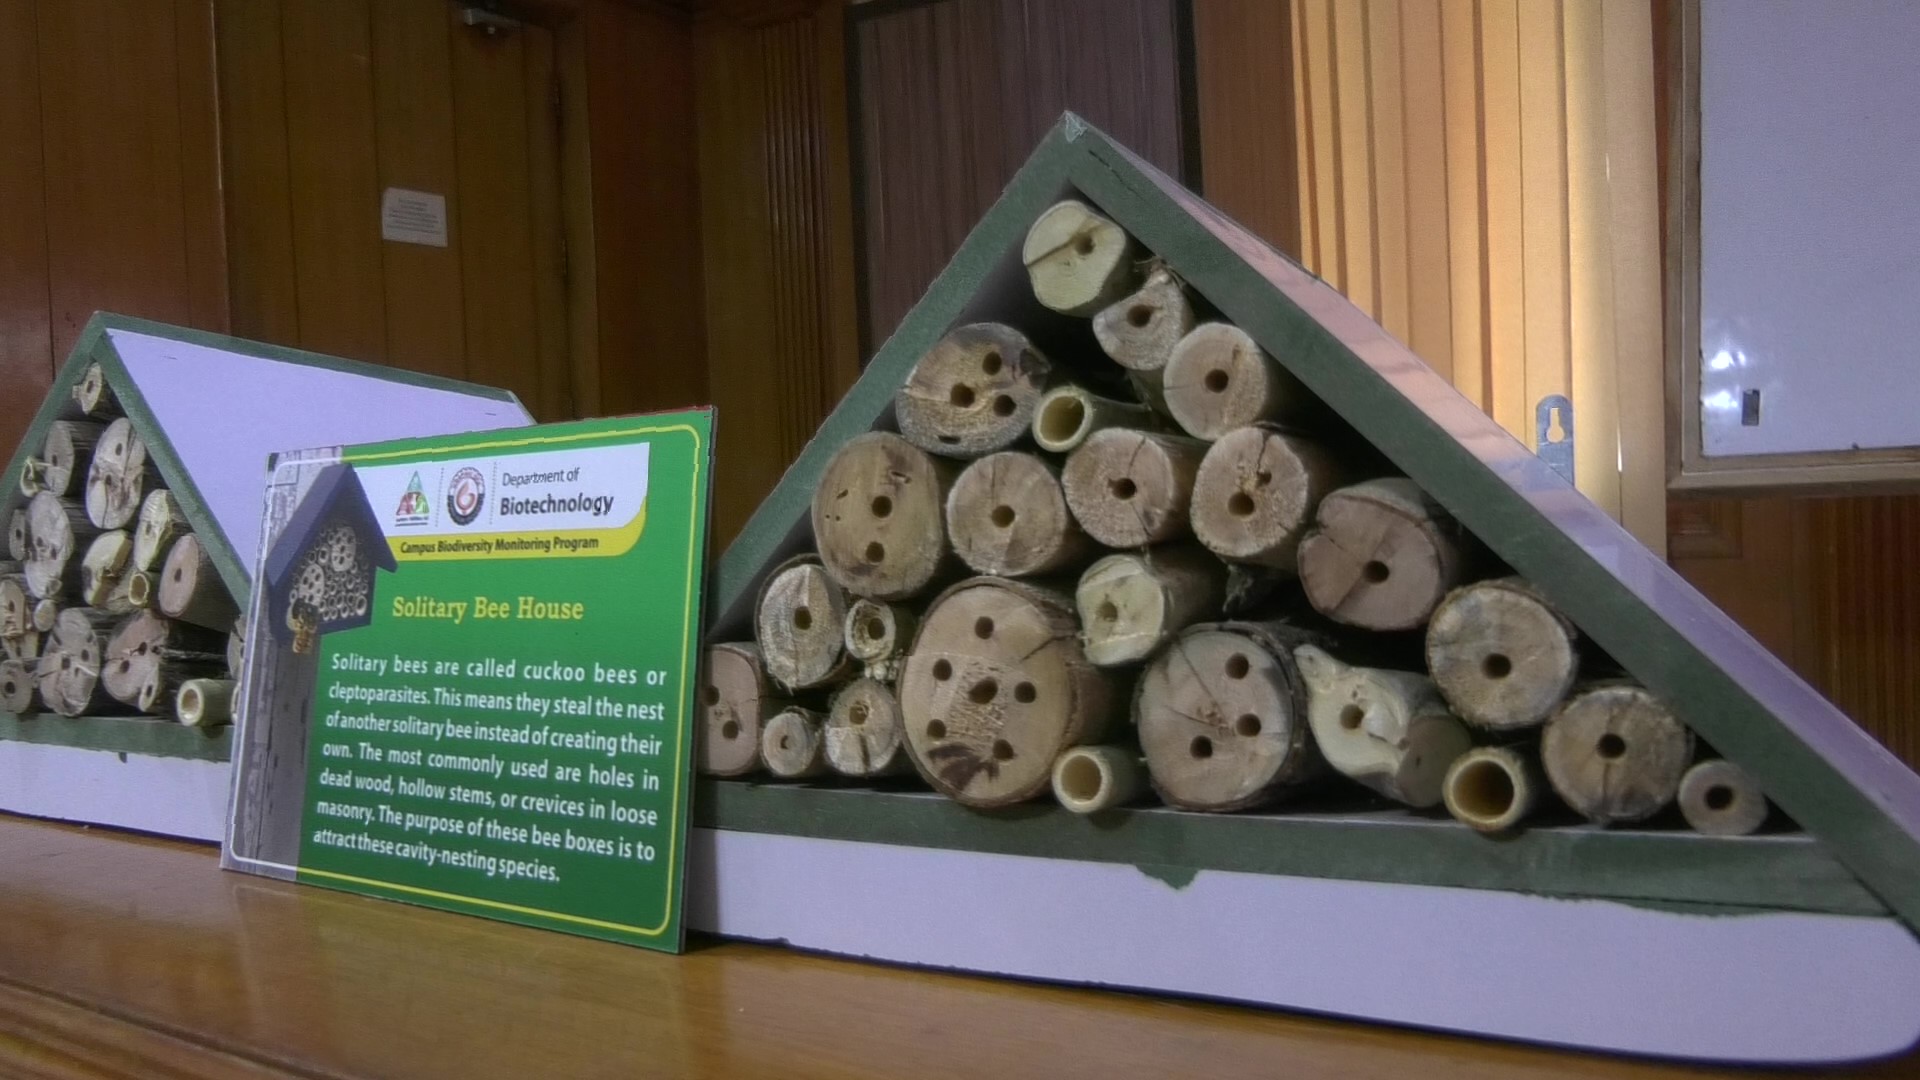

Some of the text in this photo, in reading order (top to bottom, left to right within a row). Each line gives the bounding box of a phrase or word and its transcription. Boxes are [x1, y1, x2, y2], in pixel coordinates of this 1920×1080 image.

[502, 468, 580, 487] Department of
[501, 494, 613, 516] Biotechnology
[401, 537, 598, 554] Campus Biodiversity Monitoring Program
[393, 596, 584, 624] Solitary Bee House
[332, 654, 667, 685] Solitary bees are called cuckoo bees or
[329, 682, 664, 721] cleptoparasites. This means they steal the nest
[326, 711, 662, 757] of another solitary bee instead of creating their
[323, 742, 659, 790] own. The most commonly used are holes in
[320, 769, 657, 825] dead wood, hollow stems, or crevices in loose
[317, 801, 655, 861] masonry. The purpose of these bee boxes is to
[314, 829, 560, 882] attract these cavity-nesting species.
